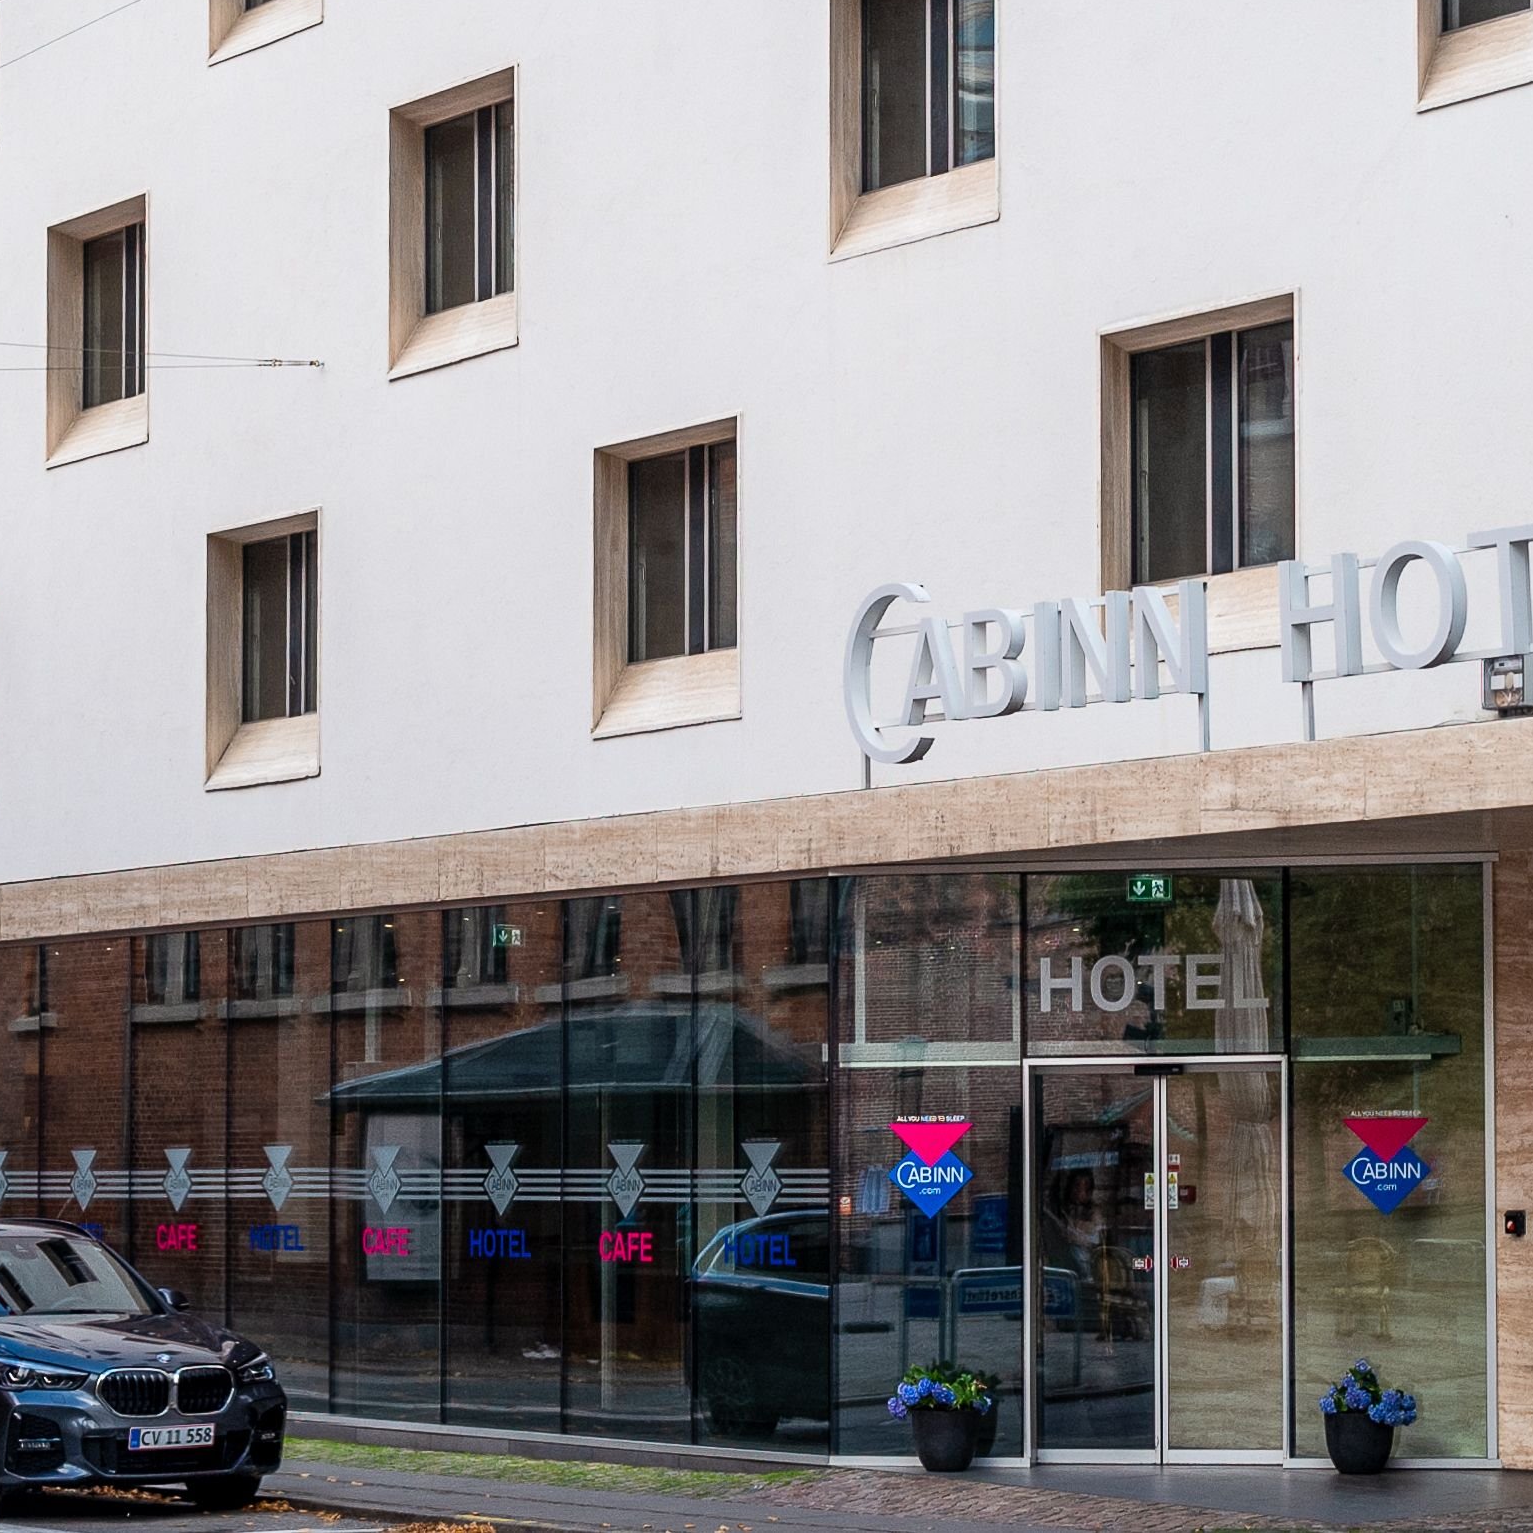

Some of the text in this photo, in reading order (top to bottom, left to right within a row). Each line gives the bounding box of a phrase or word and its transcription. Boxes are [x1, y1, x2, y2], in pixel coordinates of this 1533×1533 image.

[843, 581, 1208, 765] CABINN
[1040, 954, 1270, 1013] HOTEL
[897, 1161, 964, 1188] CABINN
[1351, 1157, 1421, 1185] CABINN
[919, 1187, 941, 1195] .com
[156, 1224, 198, 1251] CAFE
[249, 1224, 305, 1251] HOTEL
[362, 1227, 410, 1256] CAFE
[469, 1229, 531, 1258] HOTEL
[599, 1232, 653, 1262] CAFE
[724, 1234, 796, 1265] HOTEL
[141, 1427, 212, 1446] CV 11 558
